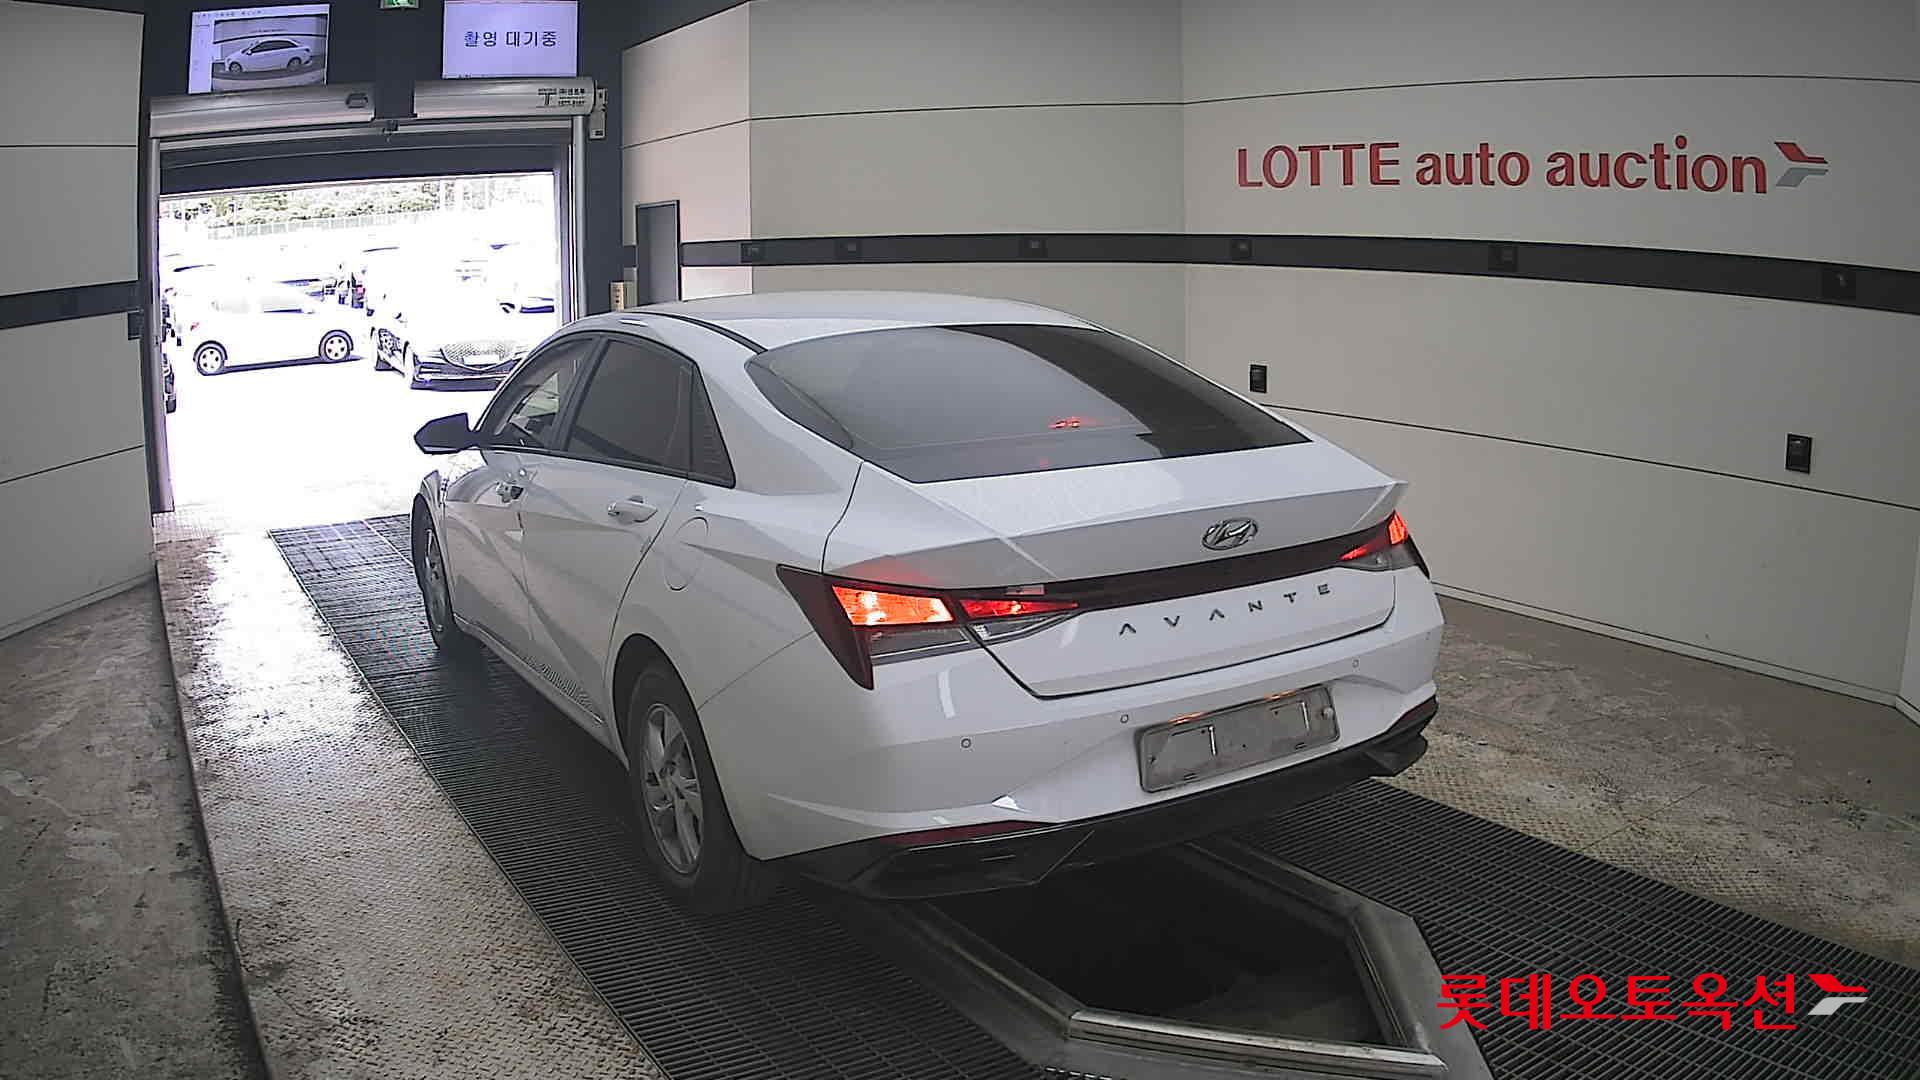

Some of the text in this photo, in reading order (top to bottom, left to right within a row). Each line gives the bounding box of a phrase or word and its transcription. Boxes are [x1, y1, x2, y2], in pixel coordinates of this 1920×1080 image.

[464, 31, 557, 47] 촬영 대기중
[1237, 136, 1767, 194] LOTTE auto auction
[1119, 583, 1331, 636] AVANTE
